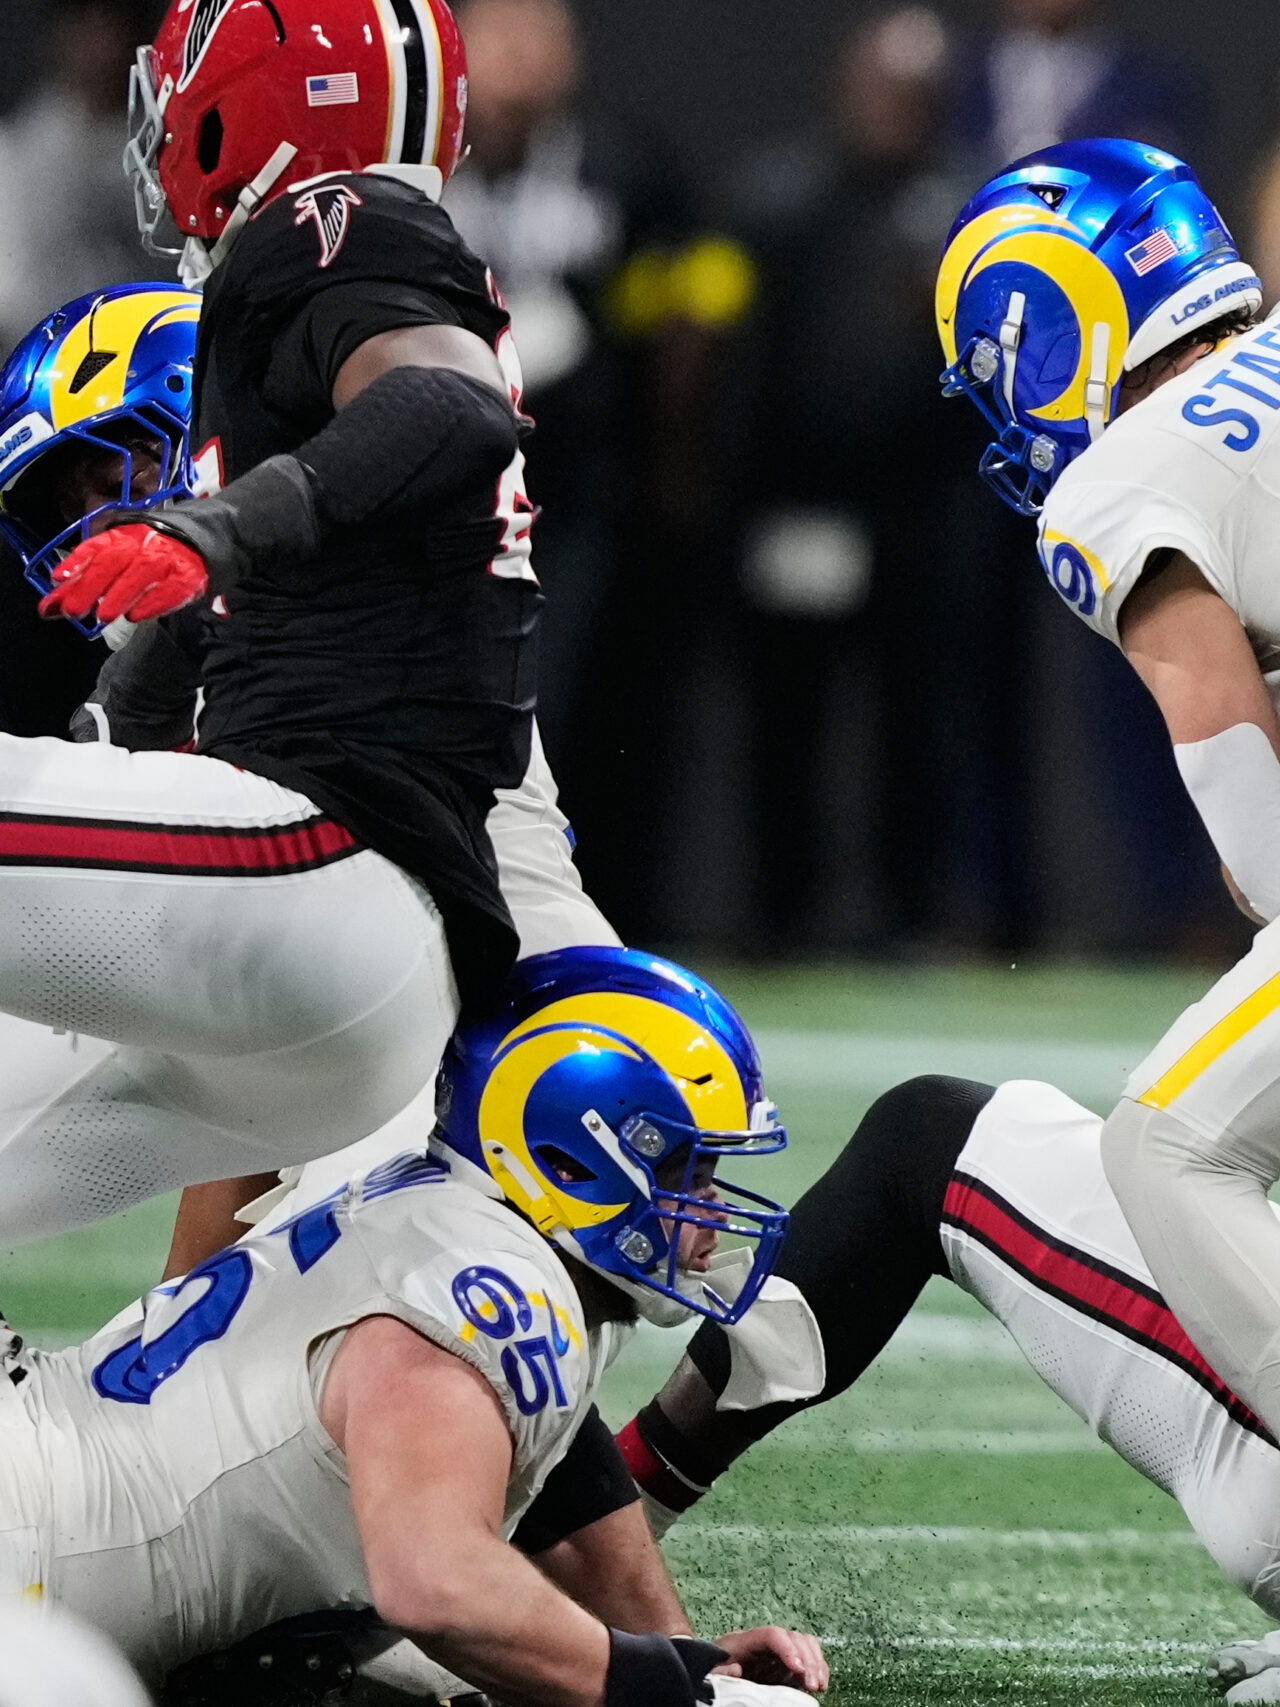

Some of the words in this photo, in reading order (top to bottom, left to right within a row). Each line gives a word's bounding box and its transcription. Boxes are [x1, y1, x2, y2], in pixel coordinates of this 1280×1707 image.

[1171, 294, 1213, 325] LOS
[1052, 541, 1097, 616] 9
[451, 1265, 569, 1416] 65
